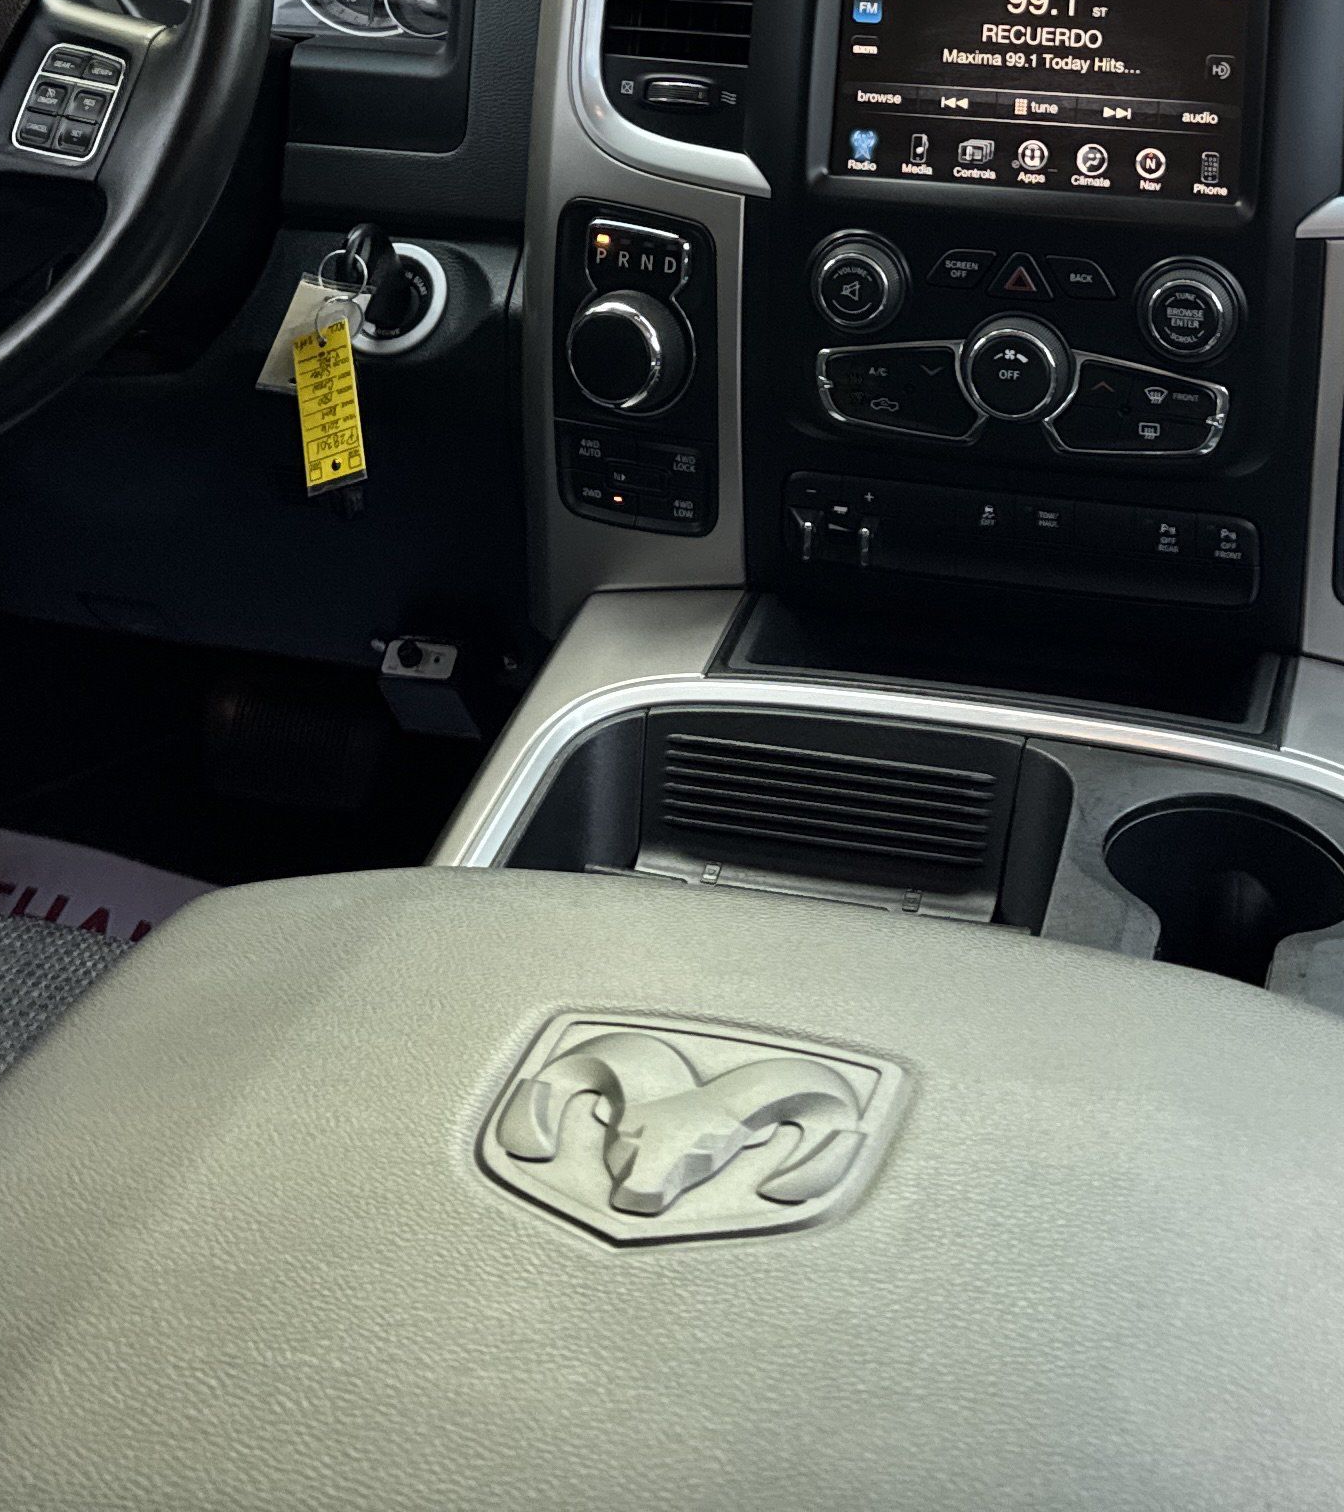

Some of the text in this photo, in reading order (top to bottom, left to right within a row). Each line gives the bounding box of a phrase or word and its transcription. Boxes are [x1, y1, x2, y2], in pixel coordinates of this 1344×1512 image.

[859, 1, 878, 14] FM
[1091, 6, 1109, 18] ST
[981, 23, 1103, 49] RECUERDO
[942, 48, 1141, 75] Maxima 99.1 Today Hits...
[856, 89, 902, 105] browse
[1030, 101, 1059, 115] tune
[1181, 111, 1219, 125] audio
[847, 159, 877, 172] Radio
[901, 162, 933, 176] Media
[952, 166, 997, 180] Controls
[1017, 171, 1046, 184] Apps
[1070, 174, 1111, 188] Climate
[1139, 179, 1162, 192] Nav
[1192, 183, 1228, 197] Phone
[596, 247, 677, 274] P R N D
[945, 258, 979, 271] SCREEN
[837, 265, 868, 277] VOLUME
[950, 268, 967, 279] OFF
[1069, 272, 1093, 283] BACK
[1175, 292, 1197, 302] TUNE
[1167, 307, 1205, 319] BROWSE
[1171, 318, 1200, 329] ENTER
[868, 366, 888, 377] A/C
[998, 368, 1021, 381] OFF
[1172, 391, 1200, 403] FRONT
[580, 438, 600, 449] 4WD
[578, 447, 602, 458] AUTO
[674, 454, 696, 464] 4WD
[673, 462, 696, 473] LOCK
[582, 487, 602, 499] 2WD
[673, 499, 694, 510] 4WD
[673, 508, 694, 519] LOW
